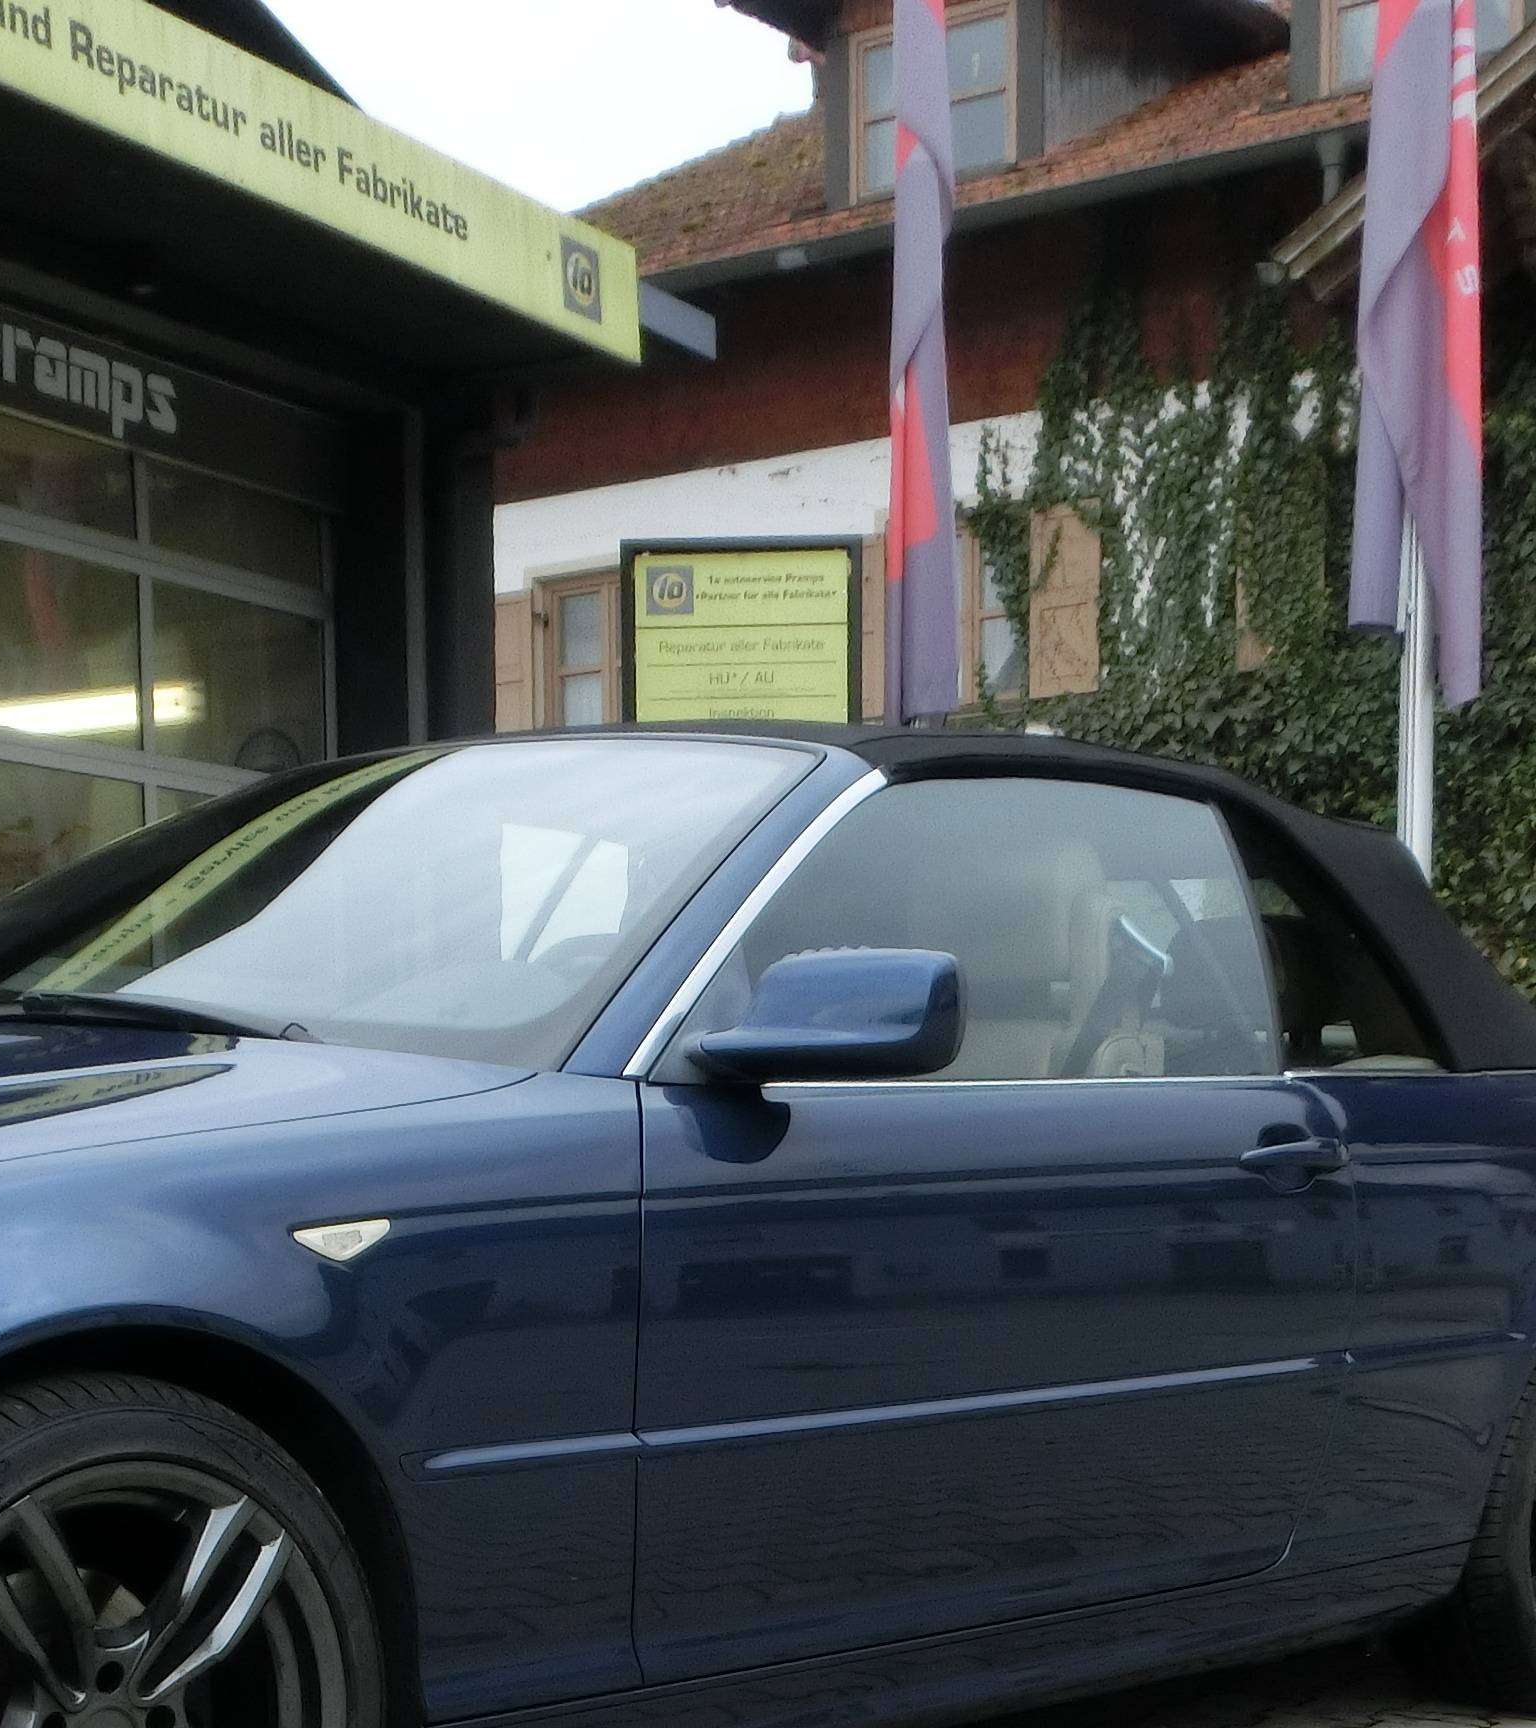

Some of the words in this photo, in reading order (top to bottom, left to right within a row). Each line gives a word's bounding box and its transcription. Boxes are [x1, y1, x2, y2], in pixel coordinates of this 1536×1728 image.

[69, 18, 248, 138] Reparatur
[259, 117, 327, 174] aller
[336, 145, 470, 242] Fabrikate
